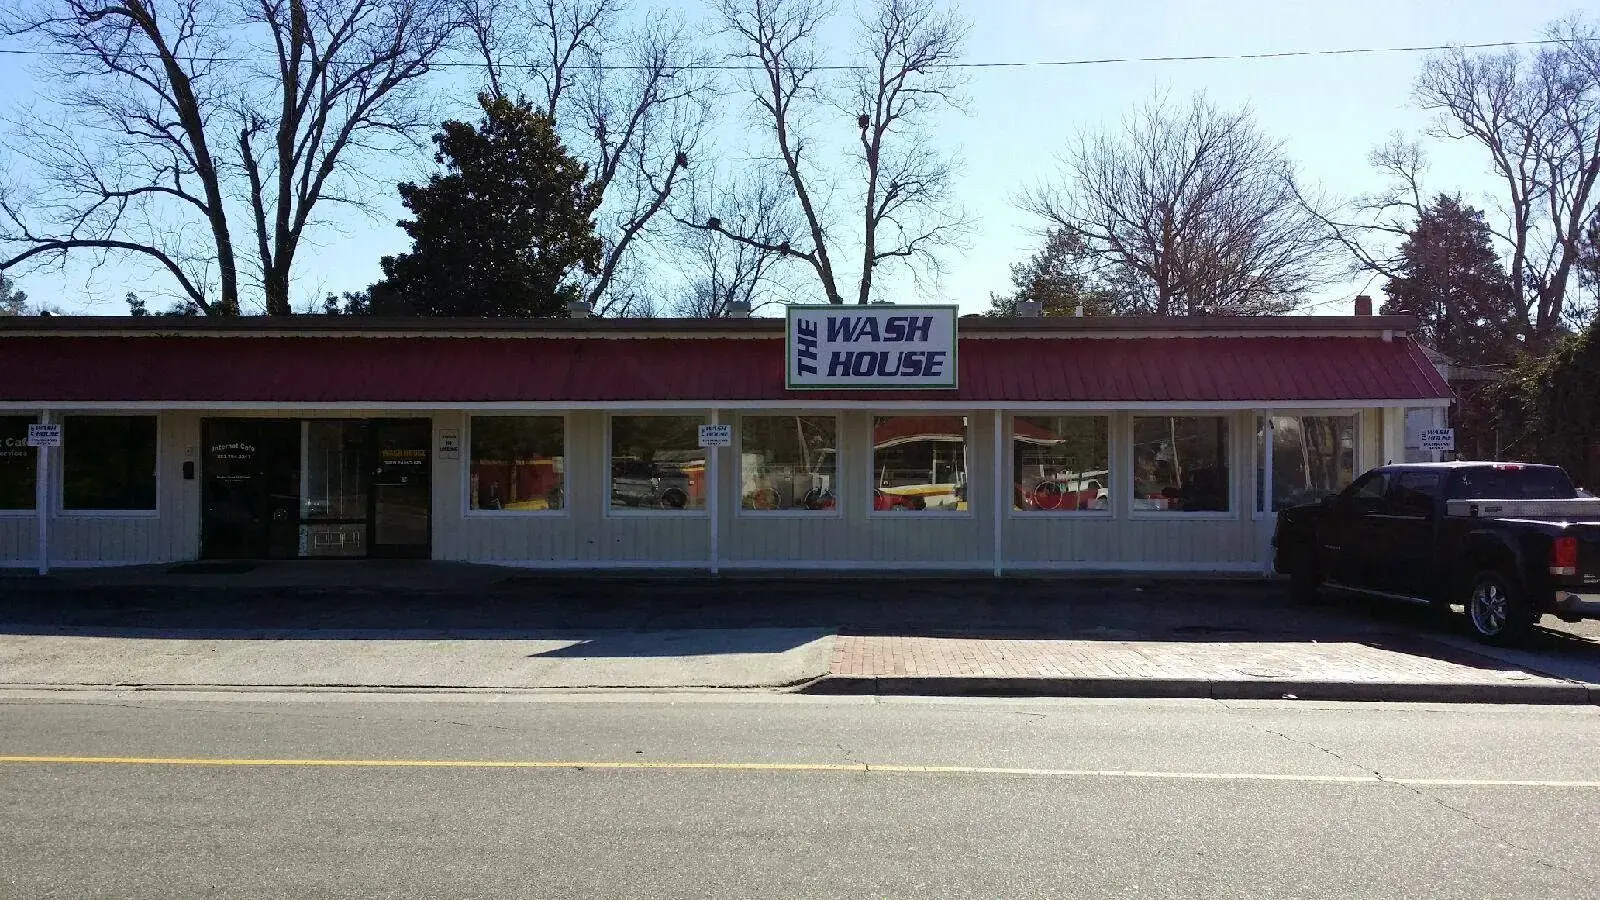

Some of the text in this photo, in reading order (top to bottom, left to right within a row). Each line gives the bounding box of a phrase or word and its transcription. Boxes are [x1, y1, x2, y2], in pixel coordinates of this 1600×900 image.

[827, 316, 934, 342] WASH
[797, 318, 818, 377] THE
[827, 351, 947, 377] HOUSE
[5, 437, 28, 447] Caf
[211, 442, 239, 453] Internet
